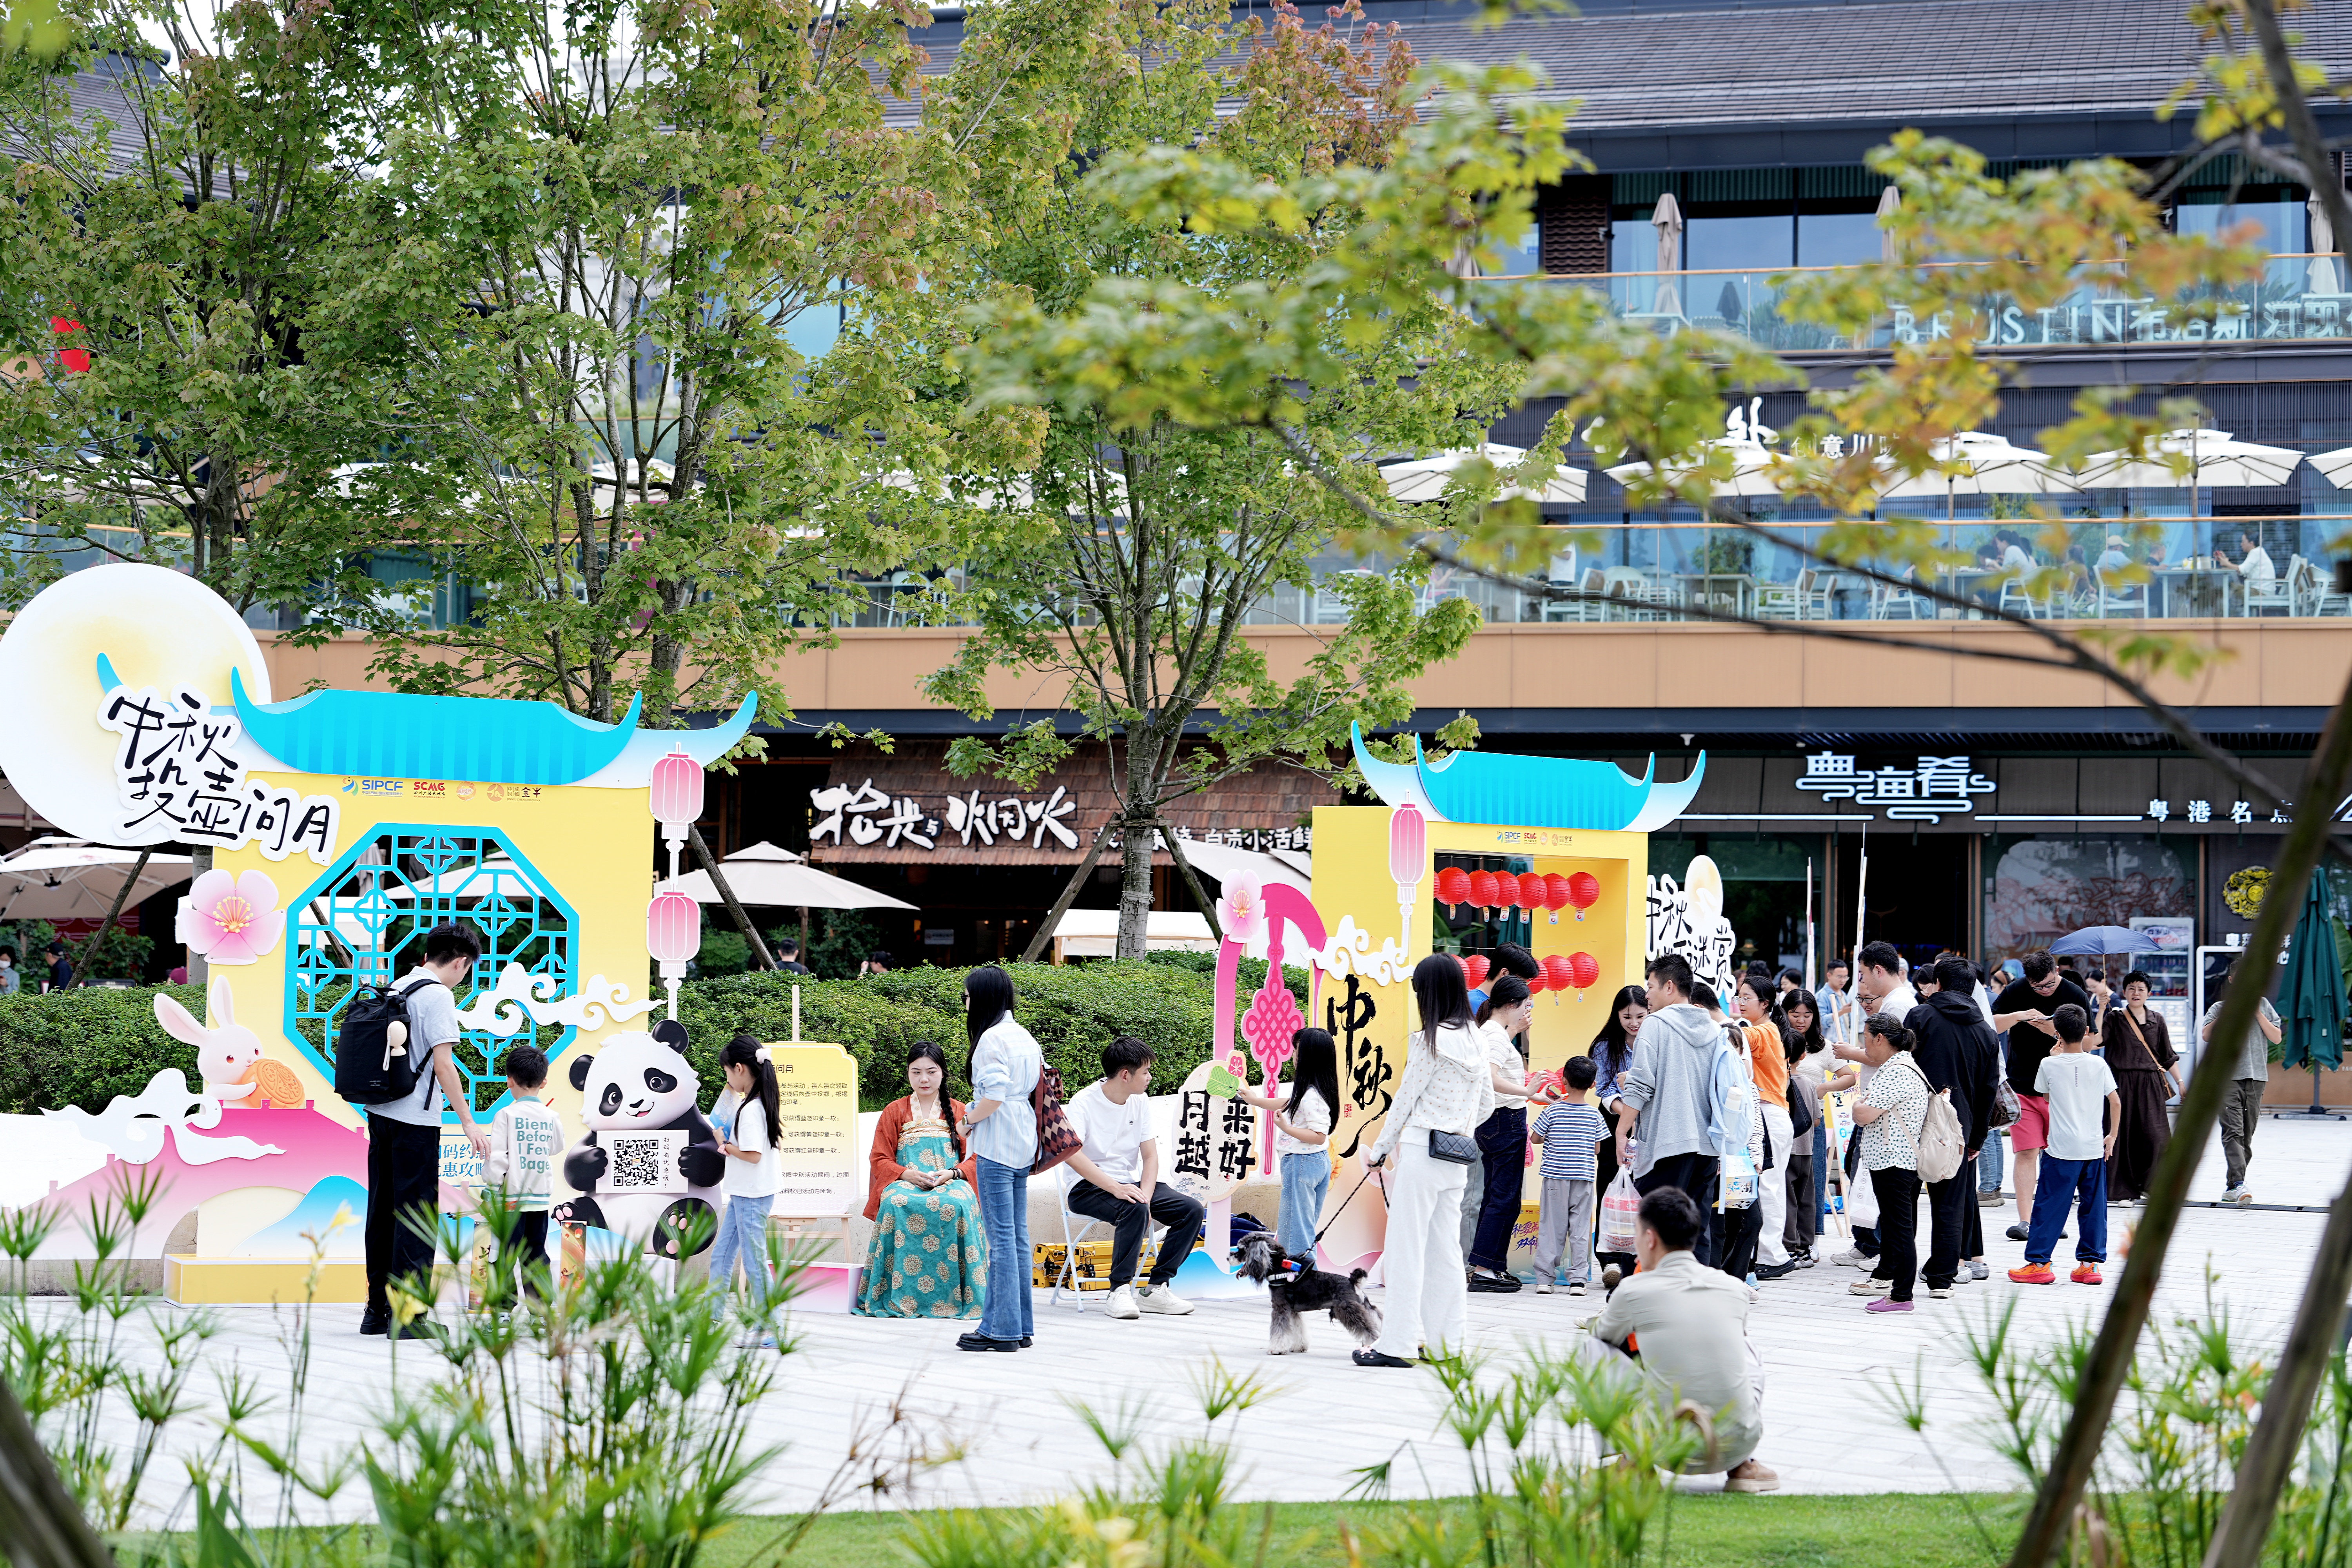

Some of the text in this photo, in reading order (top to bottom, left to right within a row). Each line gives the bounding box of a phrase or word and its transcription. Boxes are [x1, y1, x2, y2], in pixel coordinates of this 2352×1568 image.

[107, 692, 238, 770] 中秋
[123, 758, 331, 853] 投壶问月
[362, 780, 403, 791] SIPCF
[414, 781, 445, 791] SCMG
[1327, 970, 1392, 1159] 中秋
